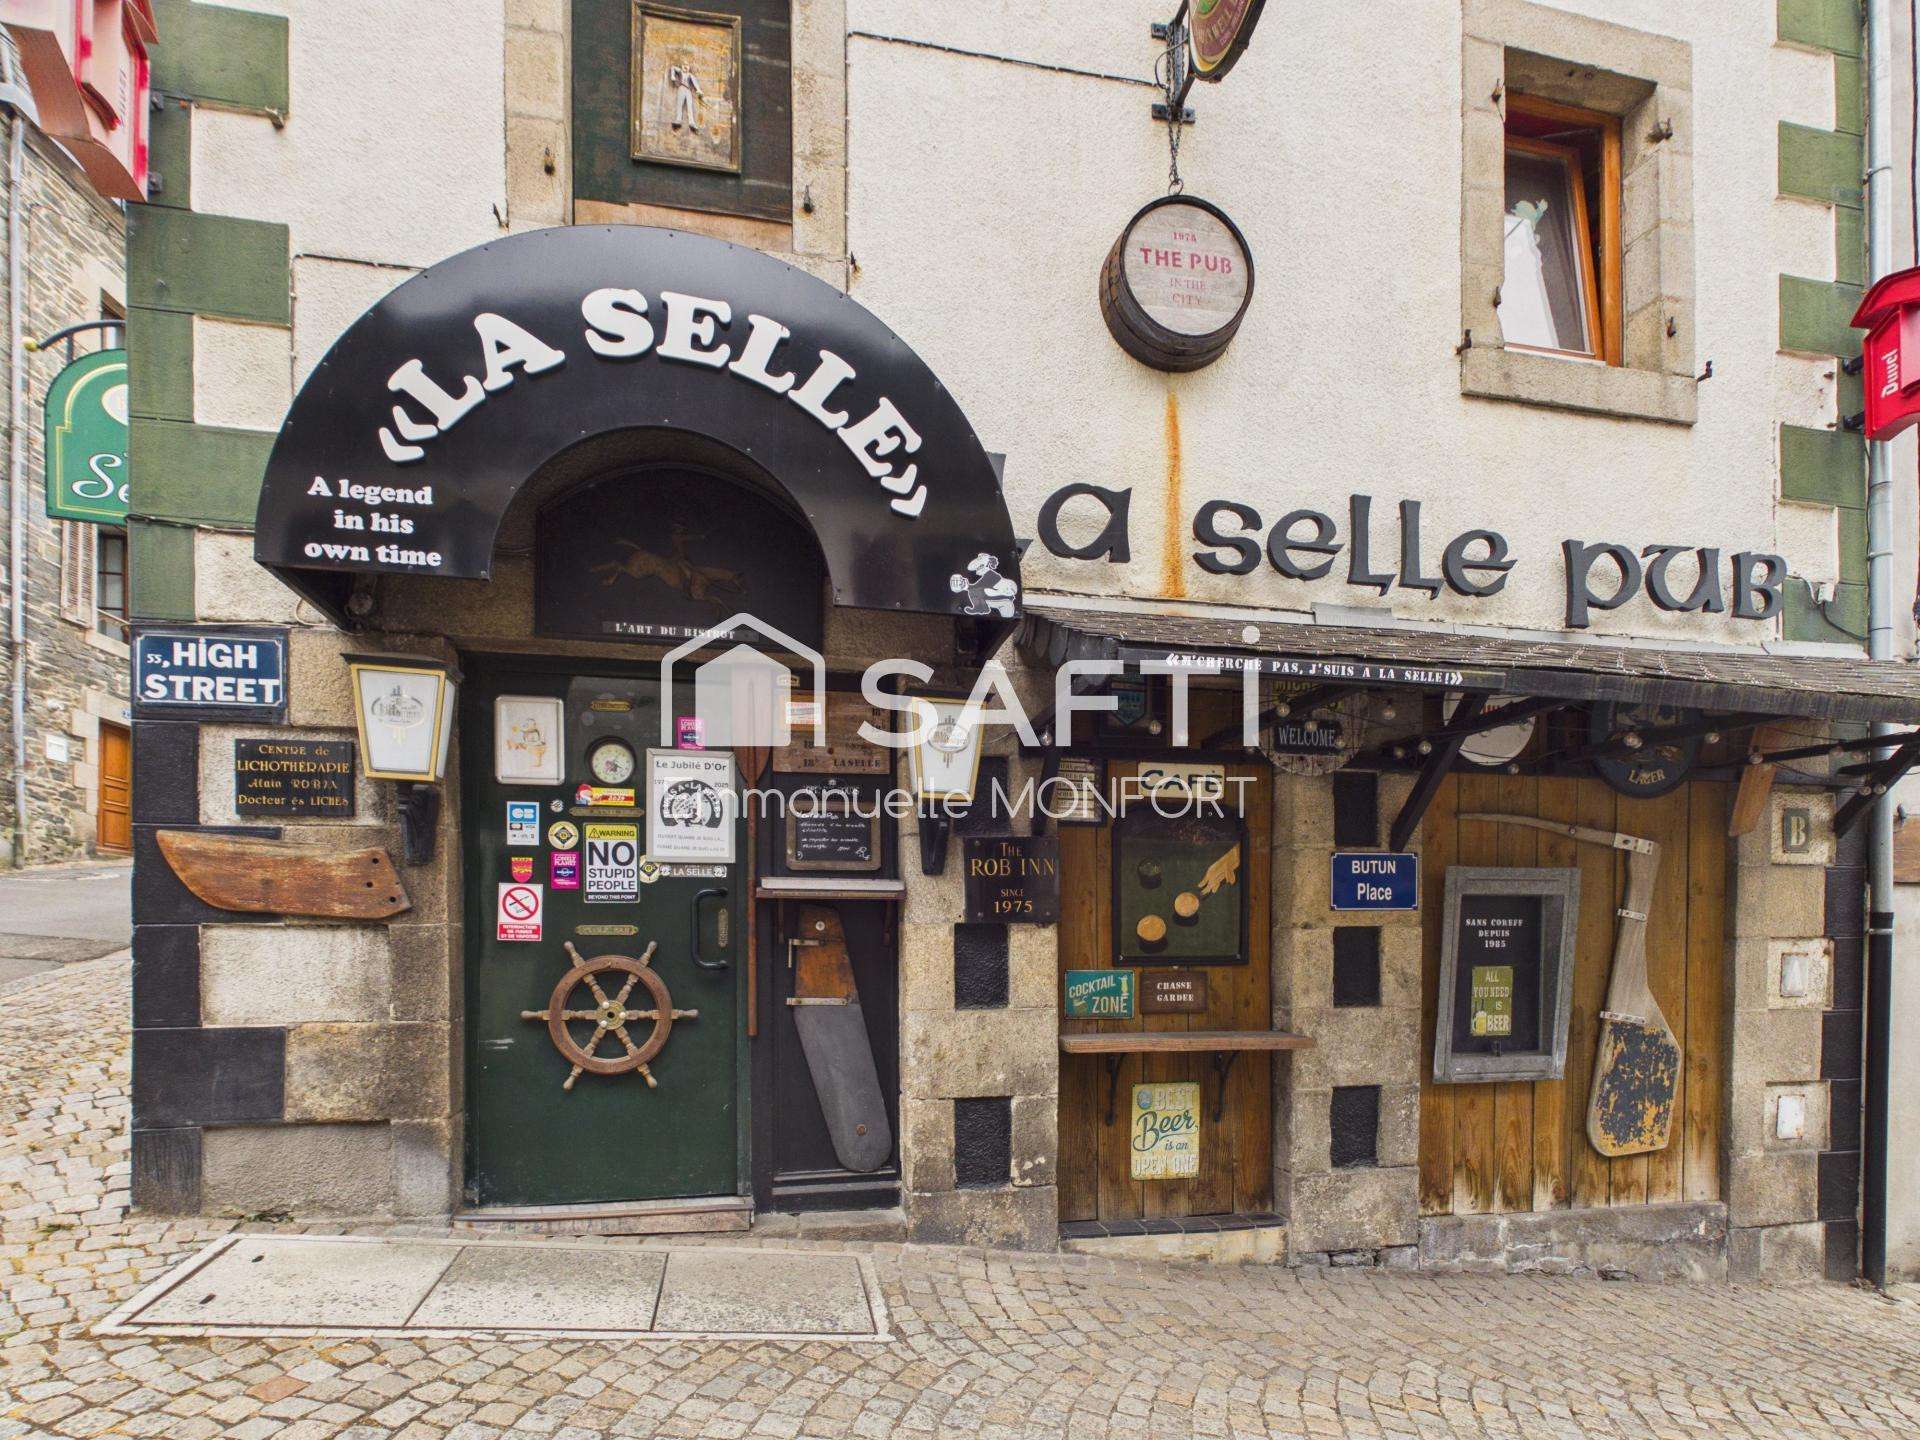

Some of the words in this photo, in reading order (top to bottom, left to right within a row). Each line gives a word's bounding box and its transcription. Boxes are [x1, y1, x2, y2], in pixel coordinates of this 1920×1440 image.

[1140, 247, 1182, 268] THE
[1190, 253, 1232, 274] PUB
[1881, 348, 1899, 398] Duvel
[307, 476, 332, 497] A
[340, 479, 434, 505] legend
[334, 510, 368, 532] in
[370, 513, 414, 535] his
[304, 541, 370, 563] own
[379, 543, 442, 568] time
[615, 622, 652, 634] L'ART
[660, 626, 676, 636] DU
[172, 638, 258, 669] HIGH
[1271, 661, 1303, 675] PAS,
[1309, 663, 1355, 677] J'SUIS
[1379, 668, 1395, 679] LA
[144, 673, 280, 704] STREET
[1278, 724, 1336, 747] WELCOME
[258, 745, 306, 756] CENTRE
[315, 746, 330, 756] de
[236, 760, 350, 774] LICHOTHERAPIE
[656, 760, 668, 769] Le
[671, 760, 701, 770] Jubilé
[704, 761, 727, 771] D'Or
[1628, 769, 1665, 785] LAGER
[238, 794, 286, 806] Docteur
[600, 829, 635, 838] WARNING
[1790, 815, 1806, 847] B
[588, 841, 636, 866] NO
[588, 868, 635, 879] STUPID
[673, 868, 684, 876] LA
[687, 868, 713, 876] SELLE
[971, 858, 1011, 876] ROB
[1021, 859, 1055, 876] INN
[1351, 860, 1396, 874] BUTUN
[588, 880, 636, 890] PEOPLE
[1357, 883, 1393, 900] Place
[1000, 888, 1024, 897] SINCE
[994, 900, 1033, 914] 1975
[1465, 919, 1488, 927] SANS
[1478, 929, 1510, 937] DEPUIS
[1485, 971, 1500, 982] ALL
[1068, 975, 1116, 998] COCKTAIL
[1156, 982, 1193, 990] CHASSE
[1473, 987, 1489, 998] YOU
[1490, 987, 1509, 998] NEED
[1092, 995, 1128, 1014] ZONE
[1495, 1001, 1503, 1010] IS
[1487, 1015, 1509, 1032] BEER
[1165, 1140, 1174, 1151] is
[1176, 1142, 1189, 1151] an
